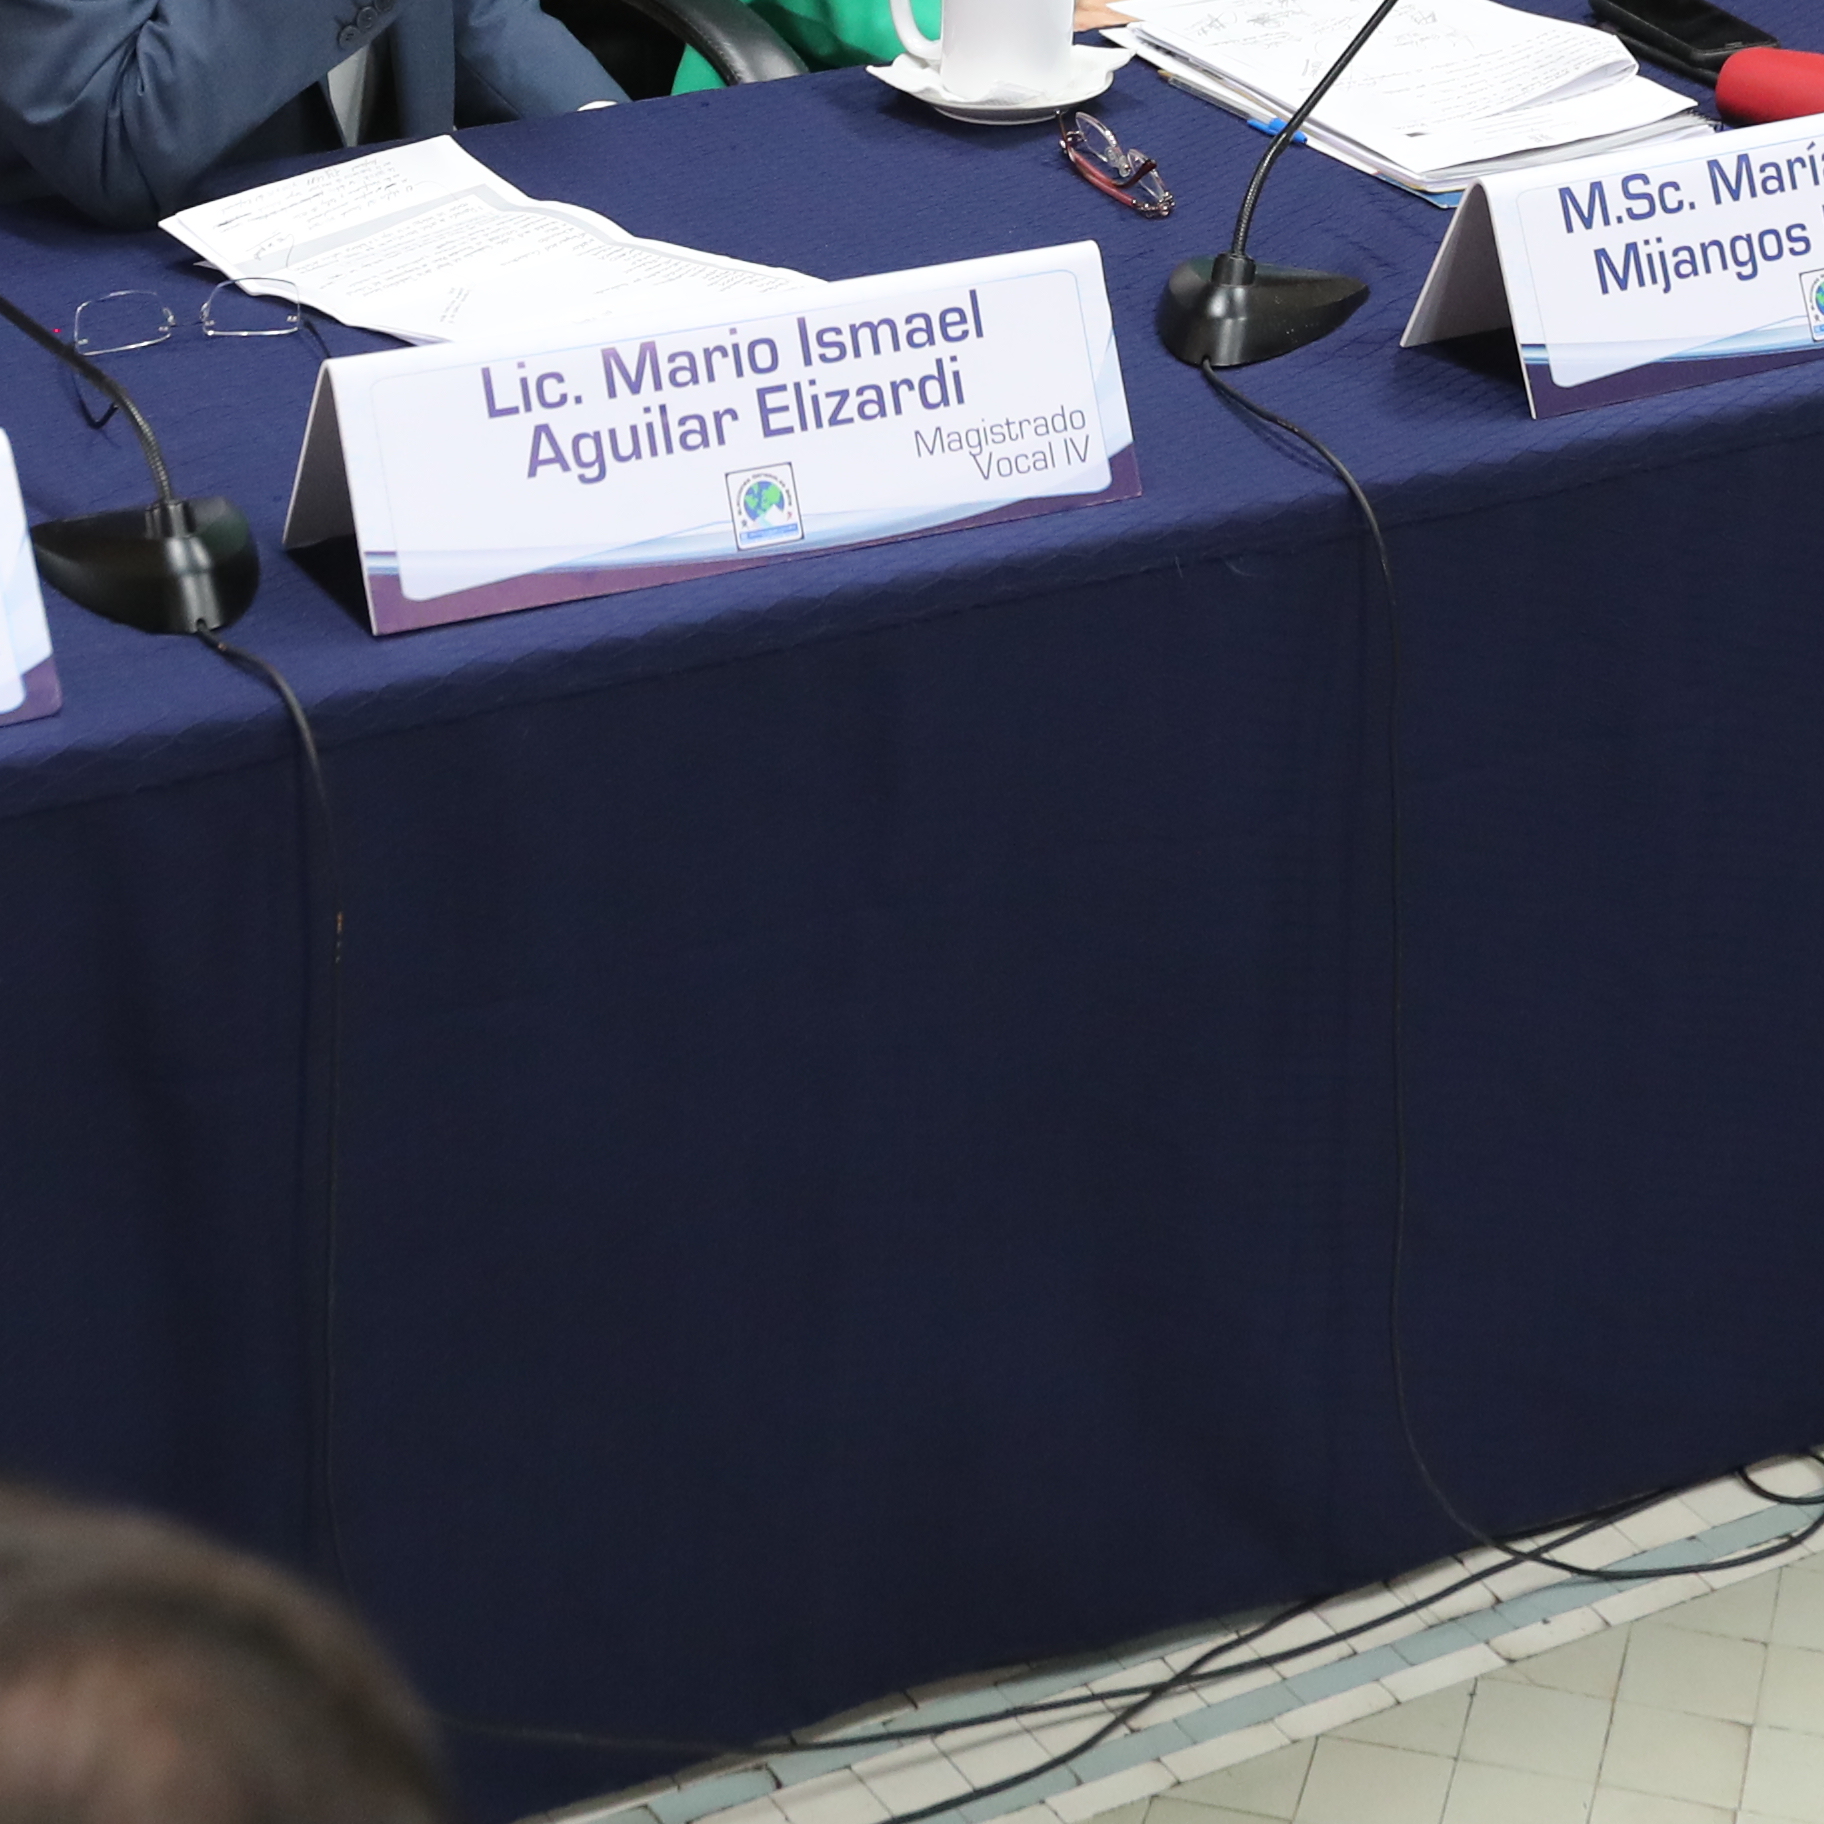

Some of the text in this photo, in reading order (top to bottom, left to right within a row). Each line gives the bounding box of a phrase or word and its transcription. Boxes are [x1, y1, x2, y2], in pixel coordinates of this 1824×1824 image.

[1557, 172, 1697, 235] M.Sc.
[1592, 222, 1812, 296] Mijangos
[480, 288, 985, 421] Lic. Mario Ismael
[526, 354, 966, 486] Aguilar Elizardi
[913, 404, 1087, 460] Magistrado
[971, 433, 1091, 482] Vocal IV
